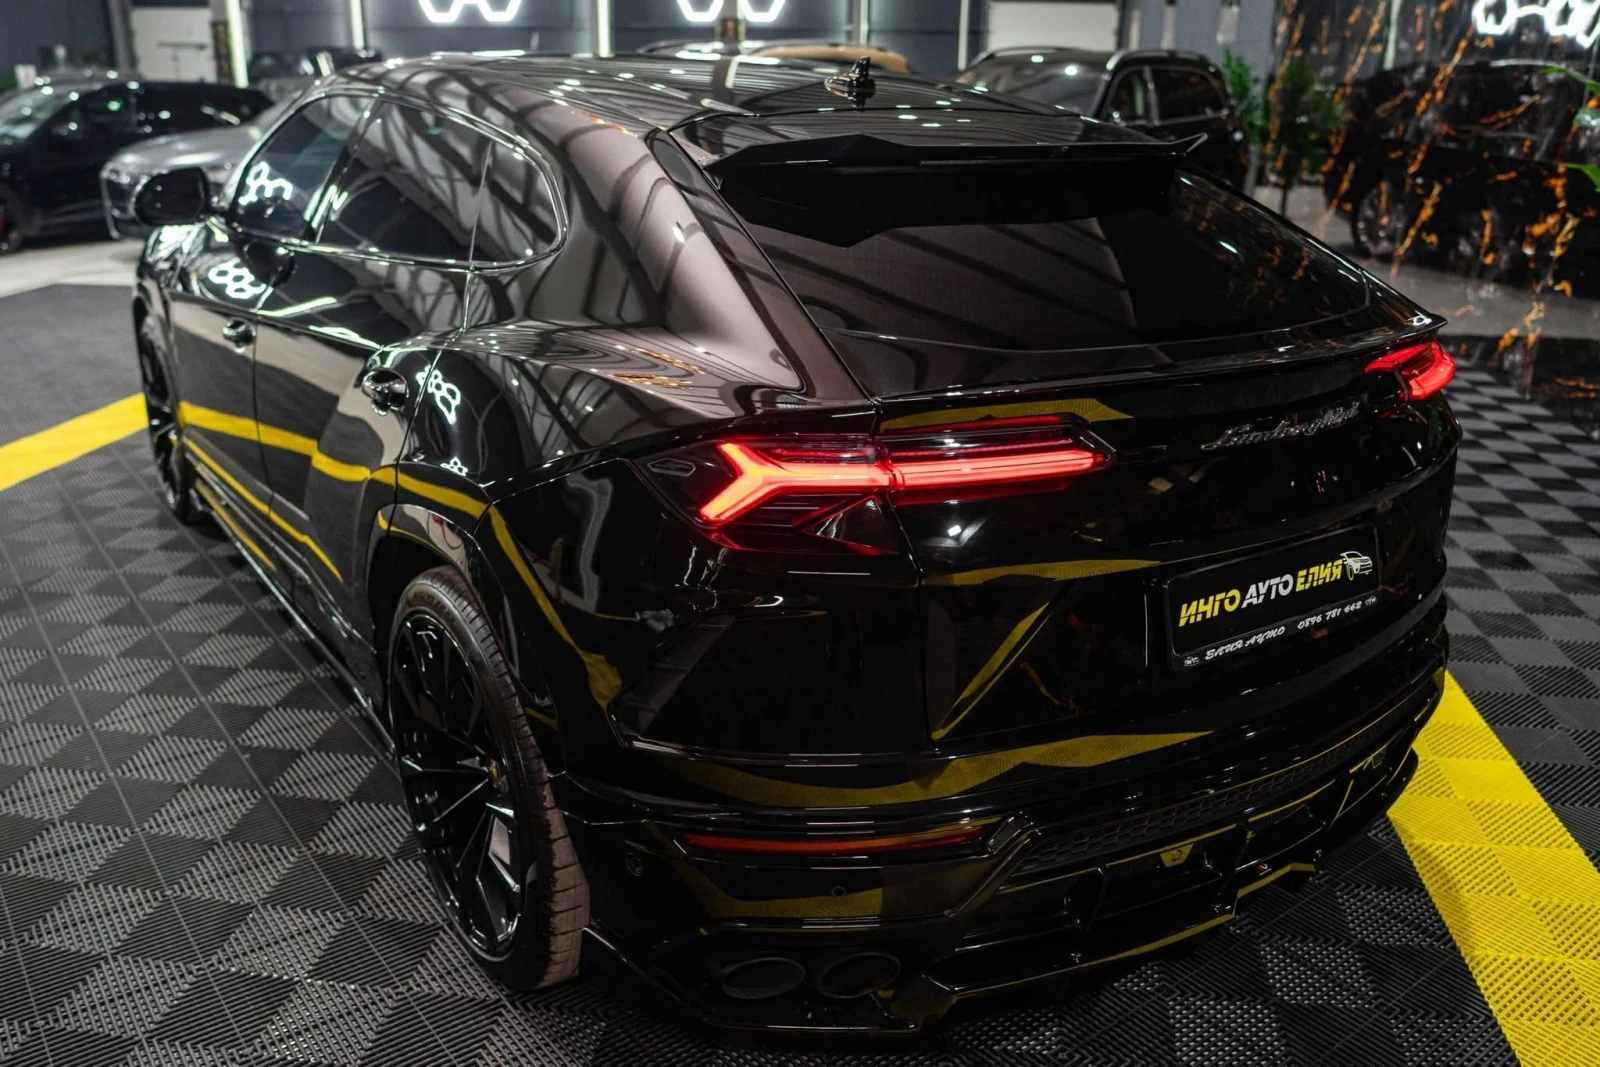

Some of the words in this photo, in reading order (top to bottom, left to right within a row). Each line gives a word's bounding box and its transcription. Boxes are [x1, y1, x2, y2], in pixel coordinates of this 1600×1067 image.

[1178, 588, 1241, 627] ИНГО
[1241, 573, 1294, 609] АУТО
[1295, 558, 1344, 592] ЕЛИЯ
